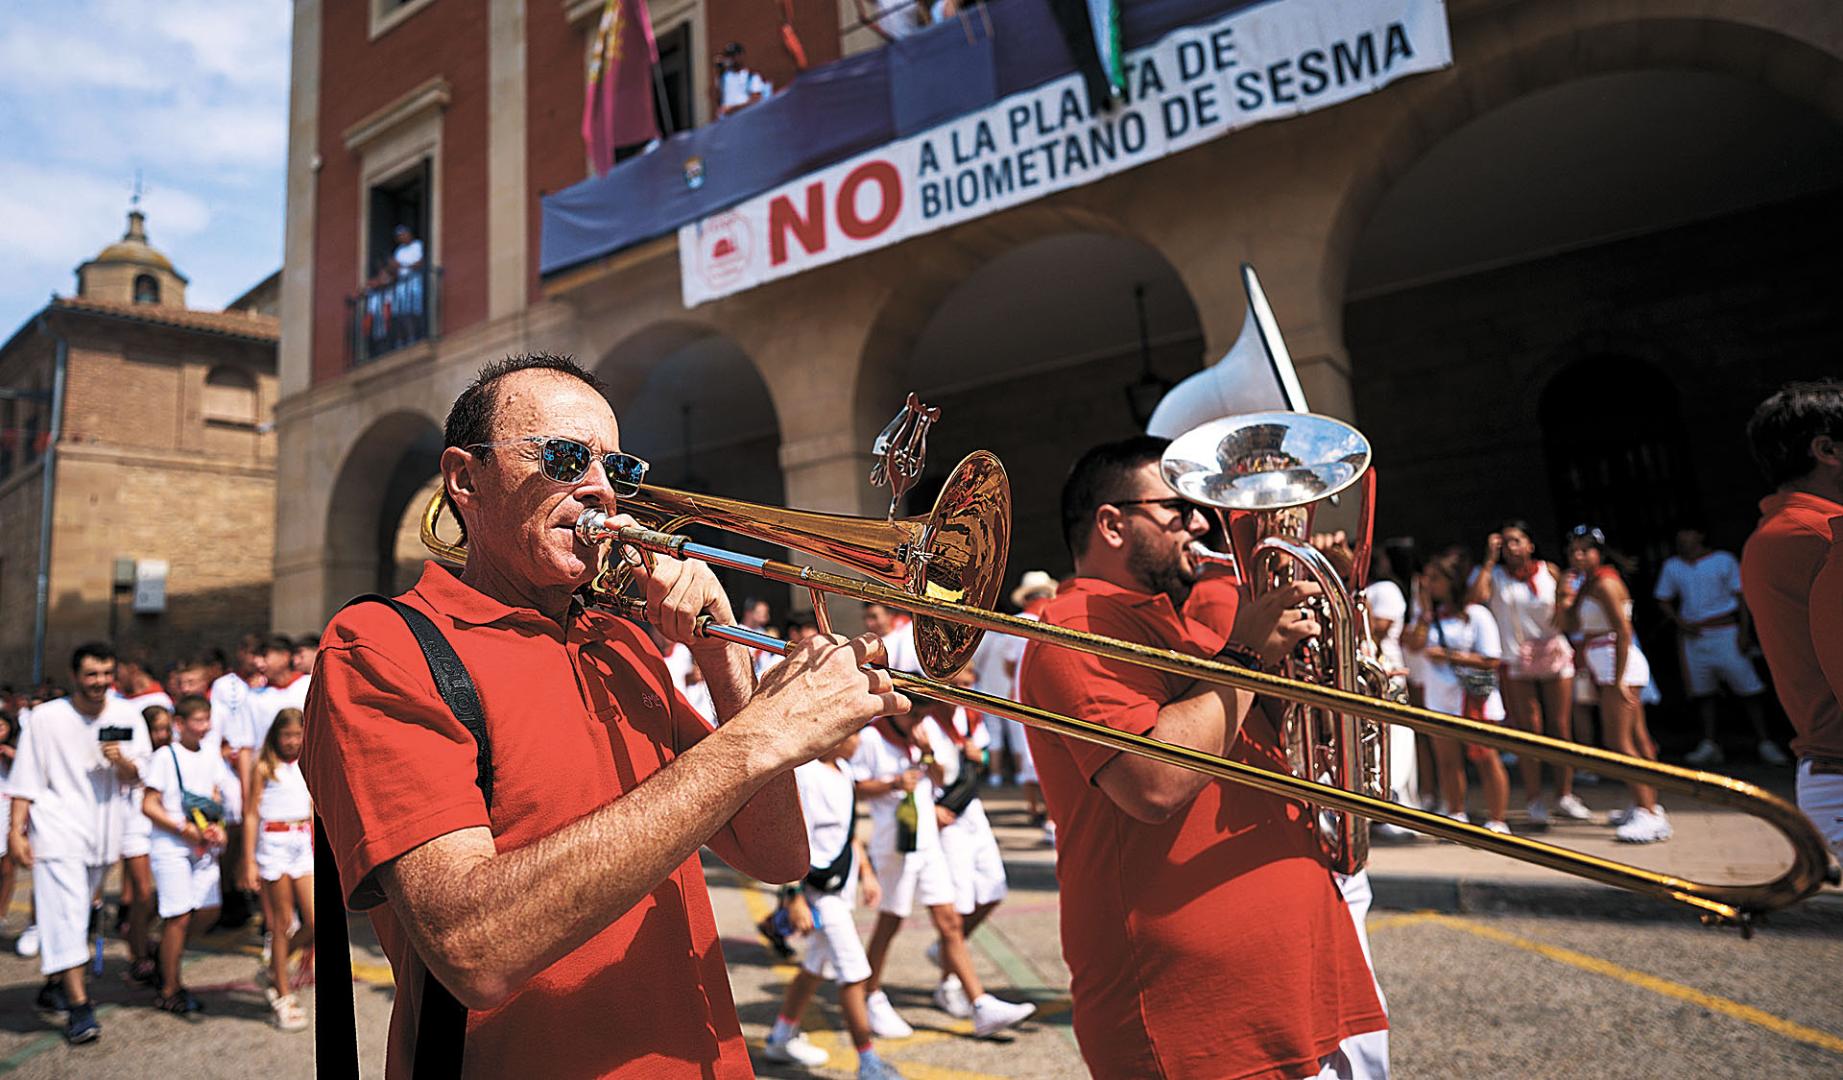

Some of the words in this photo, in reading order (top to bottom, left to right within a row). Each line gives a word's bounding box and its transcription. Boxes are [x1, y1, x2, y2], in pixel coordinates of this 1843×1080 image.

[918, 141, 940, 177] A
[951, 119, 997, 166] LA
[1008, 57, 1164, 145] PLATA
[1177, 28, 1237, 85] DE
[921, 111, 1147, 219] BIOMETANO
[1161, 83, 1220, 140] DE
[1236, 22, 1414, 111] SESMA
[767, 159, 904, 267] NO
